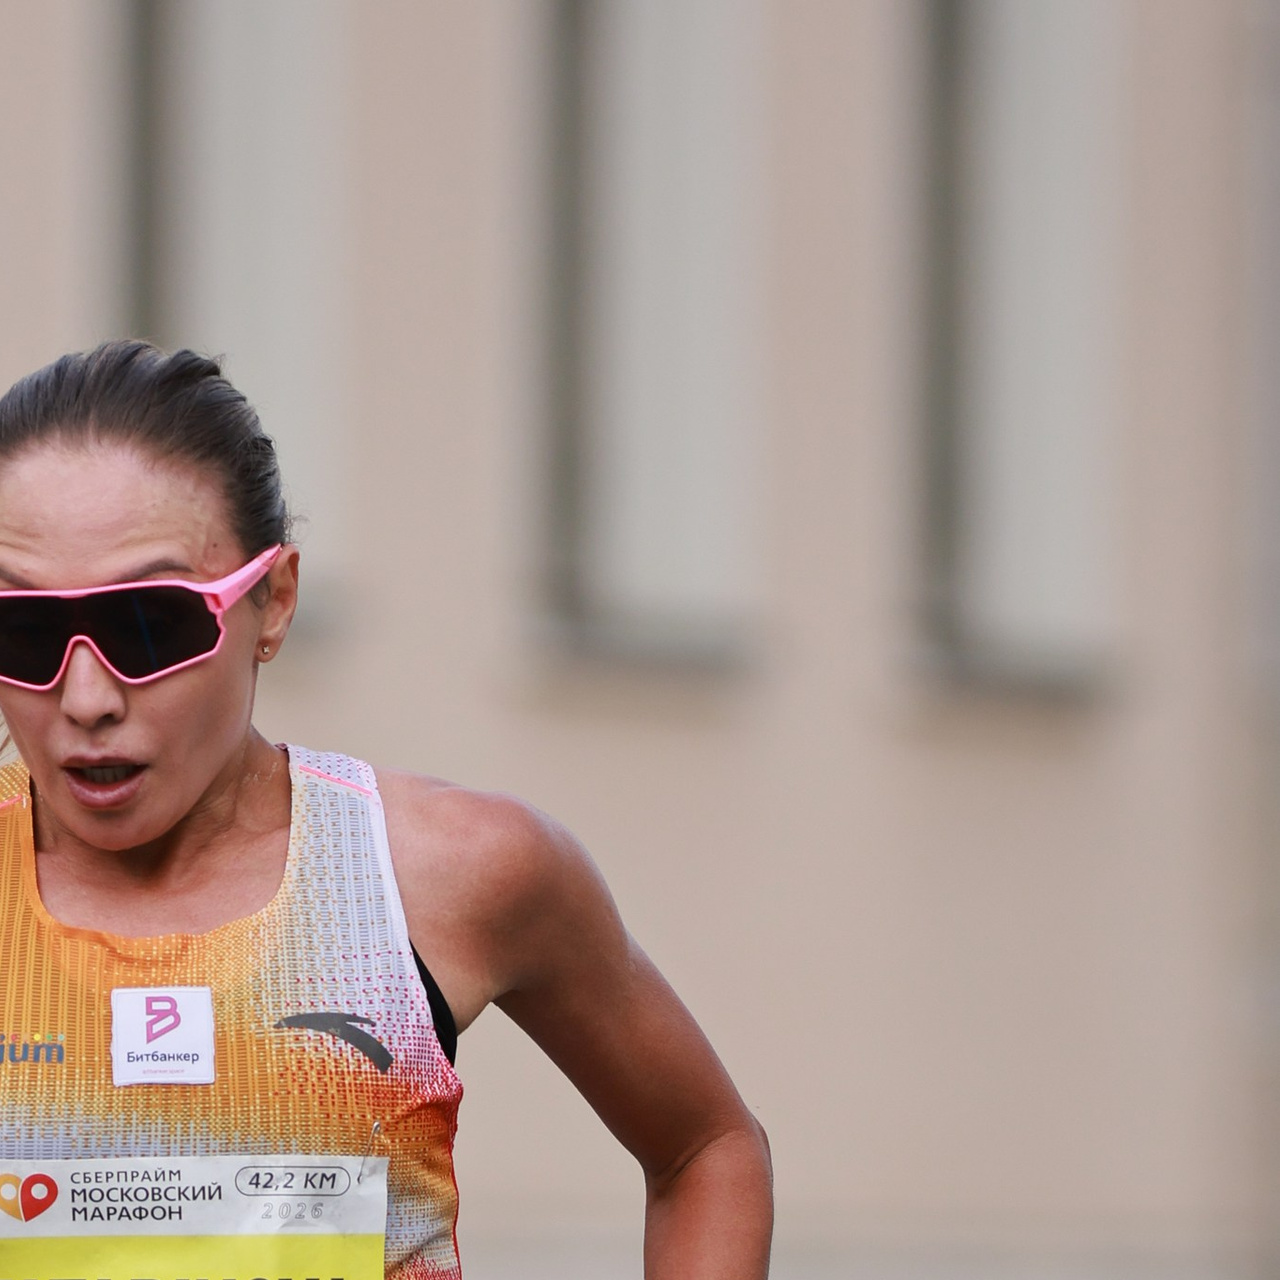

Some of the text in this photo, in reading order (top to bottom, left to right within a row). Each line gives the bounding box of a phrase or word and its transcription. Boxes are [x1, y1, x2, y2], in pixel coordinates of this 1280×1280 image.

[126, 1050, 200, 1064] Битбанкер
[70, 1167, 182, 1184] СБЕРПРАЙМ
[248, 1171, 295, 1191] 42,2
[71, 1181, 222, 1203] МОСКОВСКИЙ
[72, 1205, 182, 1221] МАРАФОН
[261, 1202, 324, 1219] 2026
